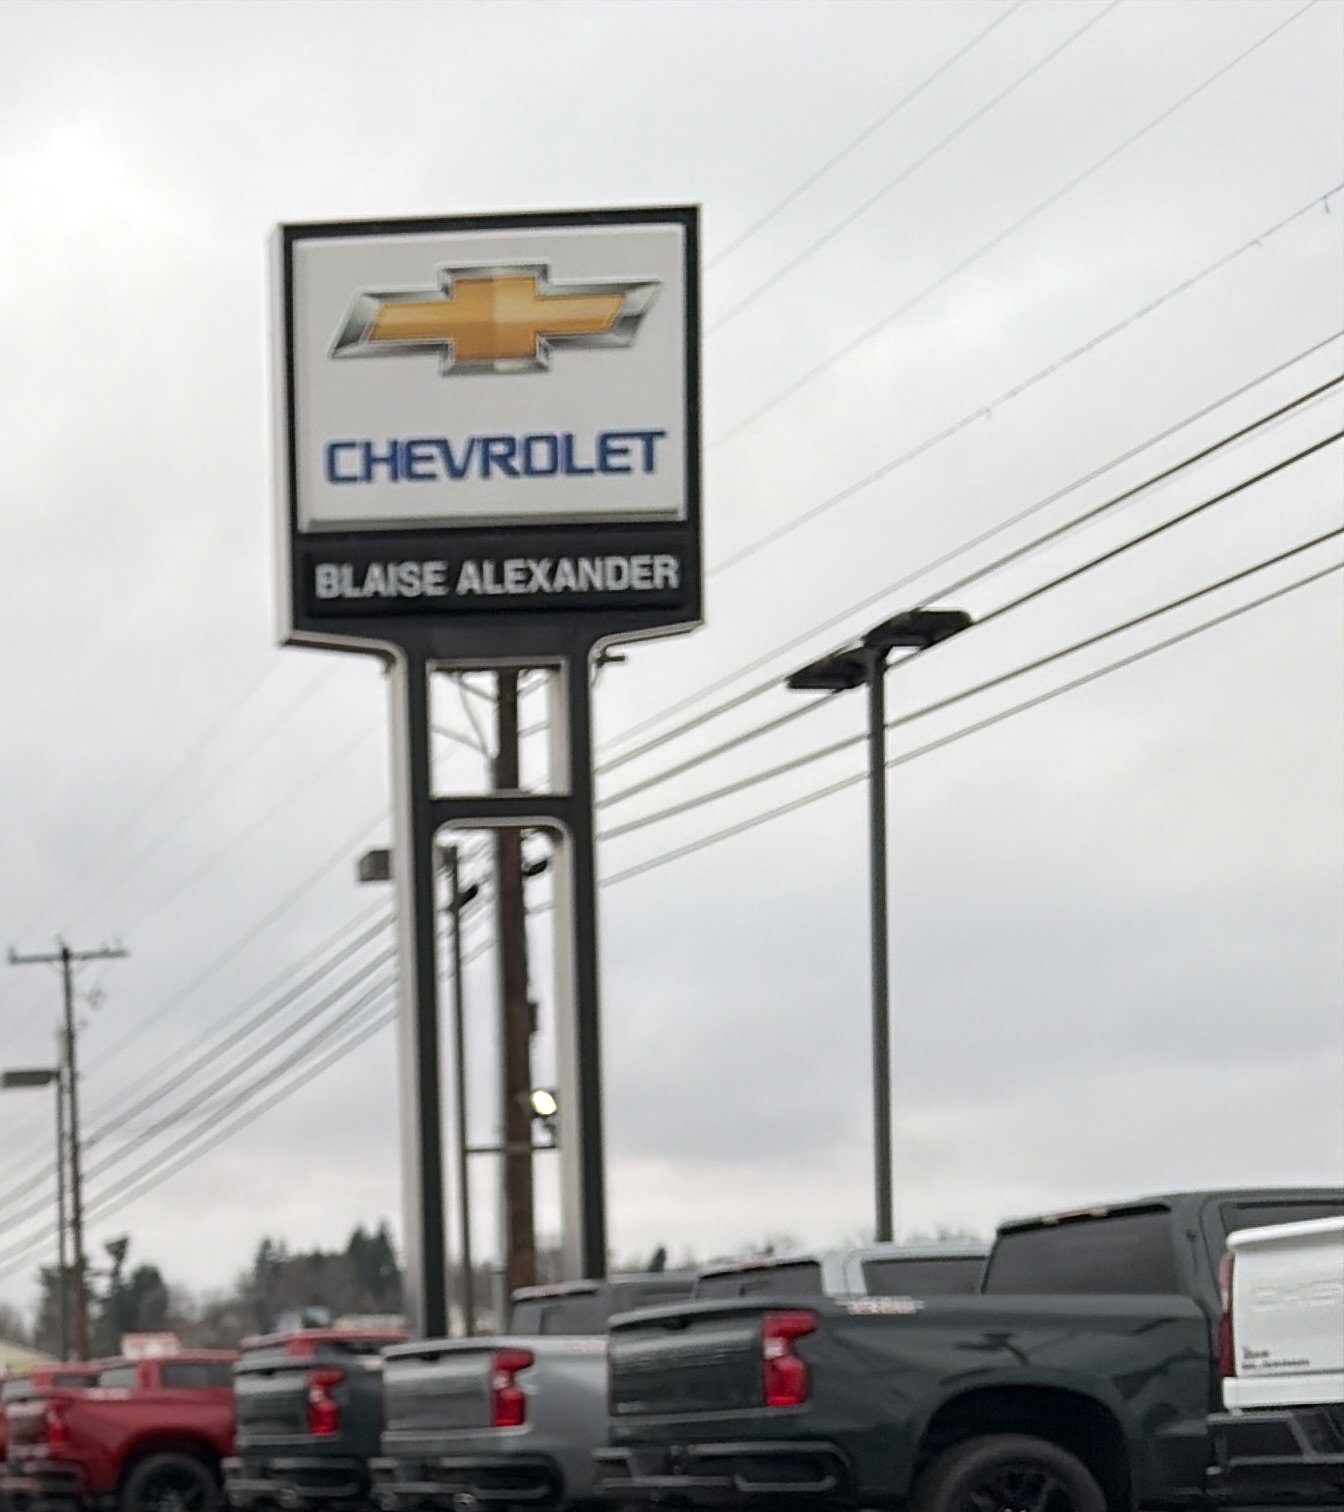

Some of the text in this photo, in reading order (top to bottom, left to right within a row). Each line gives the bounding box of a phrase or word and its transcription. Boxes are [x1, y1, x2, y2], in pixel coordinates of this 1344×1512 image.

[326, 430, 667, 484] CHEVROLET
[314, 553, 679, 599] BLAISE ALEXANDER
